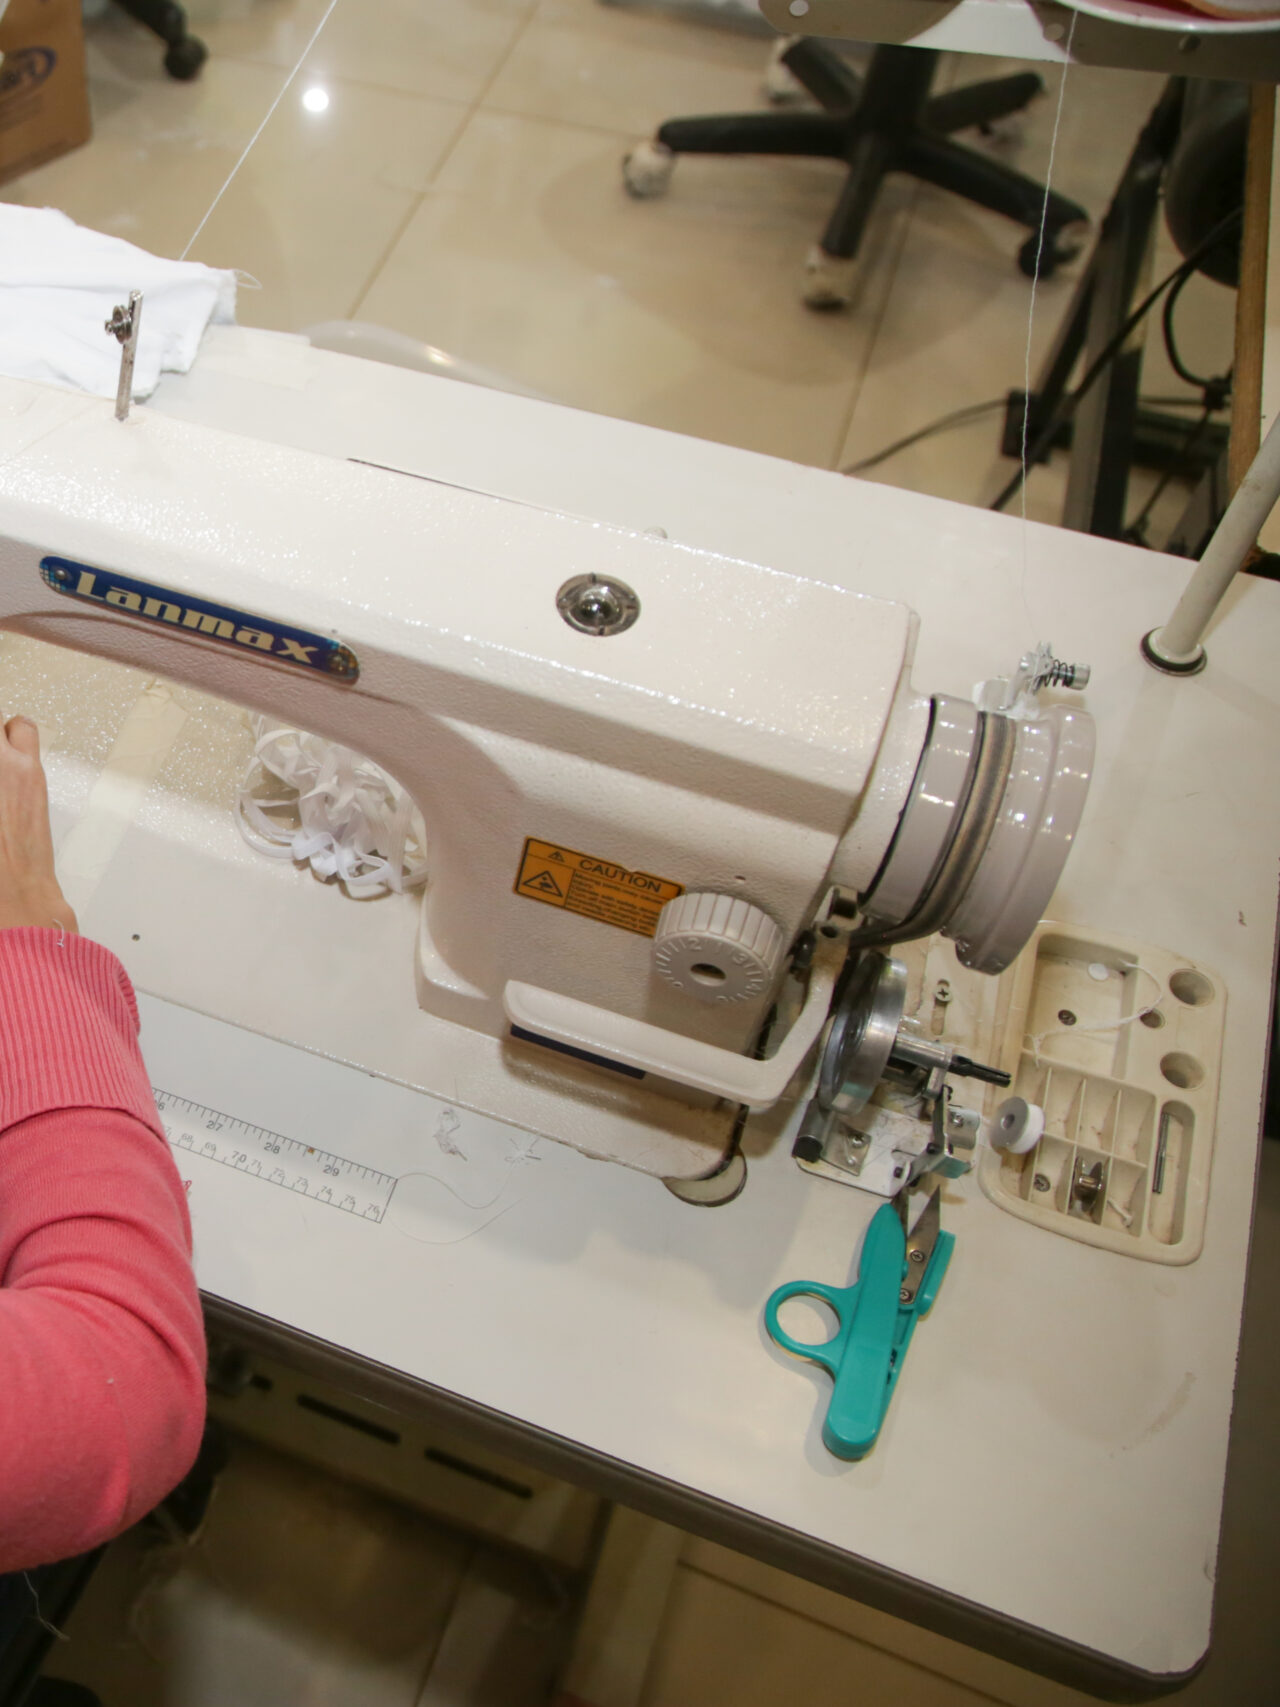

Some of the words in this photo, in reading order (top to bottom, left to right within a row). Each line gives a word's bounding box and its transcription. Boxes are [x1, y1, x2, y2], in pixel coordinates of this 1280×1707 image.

[76, 571, 319, 664] Lanmax
[579, 859, 662, 893] CAUTION
[181, 1133, 193, 1143] 68
[204, 1142, 217, 1152] 69
[231, 1150, 248, 1163] 70
[251, 1159, 262, 1168] 71
[272, 1167, 286, 1178] 72
[295, 1176, 309, 1186] 73
[320, 1185, 333, 1195] 74
[344, 1194, 357, 1204] 75
[367, 1203, 380, 1213] 76
[206, 1120, 223, 1132] 27
[263, 1142, 281, 1154] 28
[322, 1164, 340, 1177] 29
